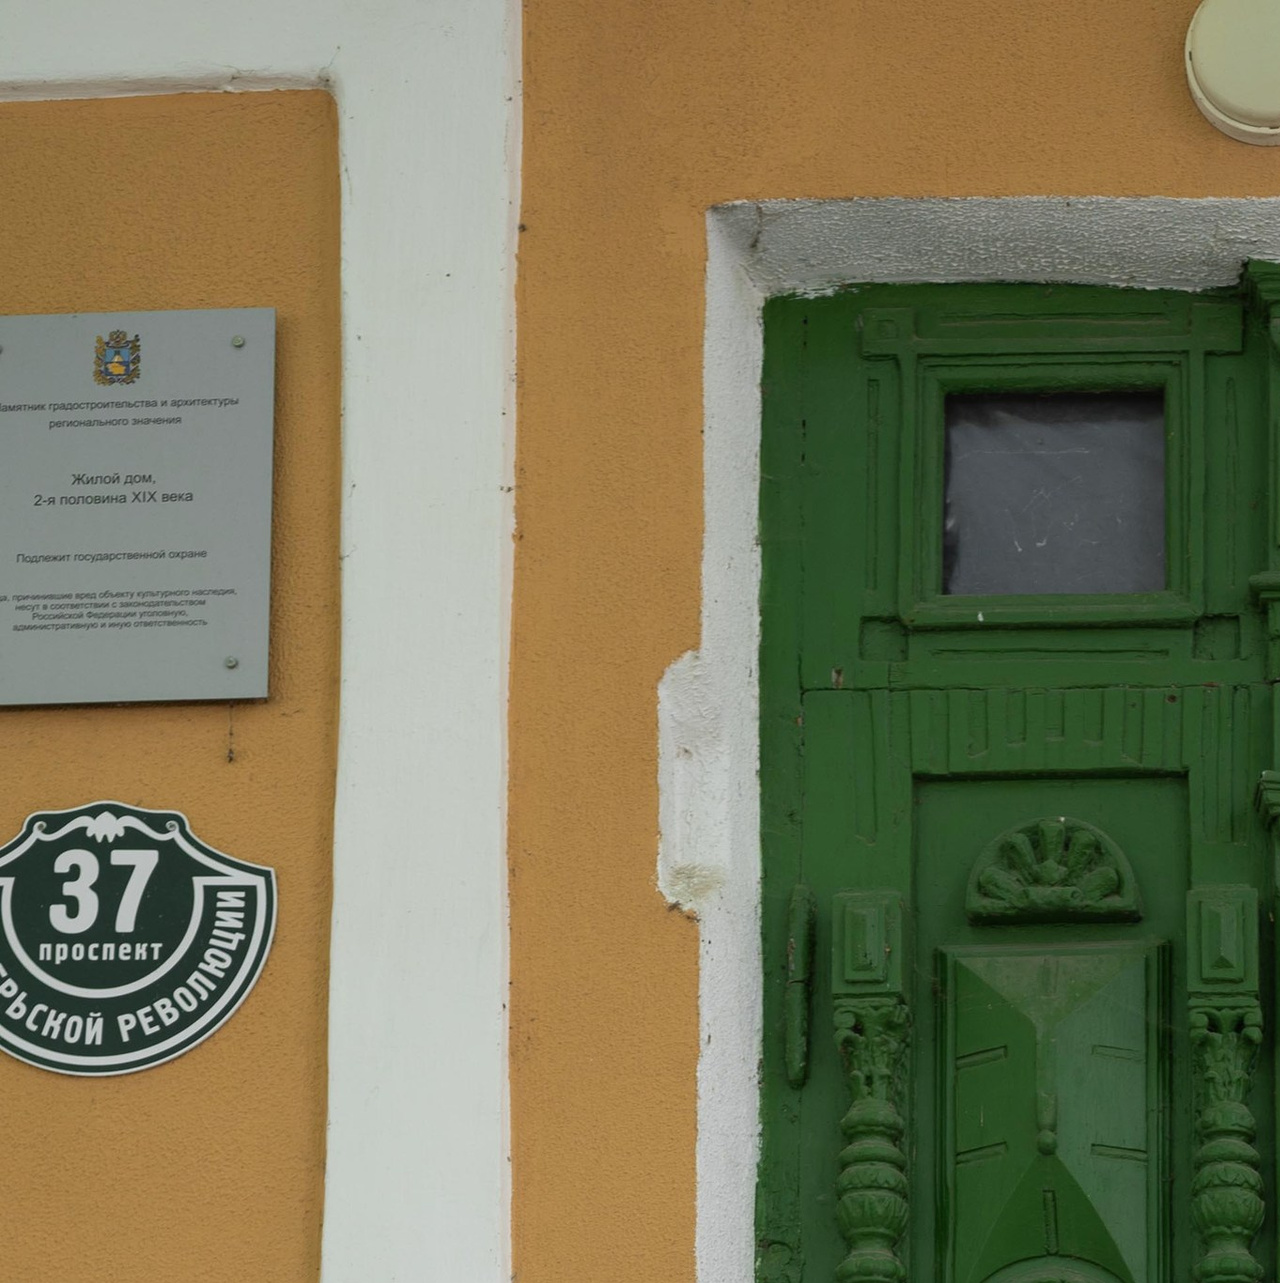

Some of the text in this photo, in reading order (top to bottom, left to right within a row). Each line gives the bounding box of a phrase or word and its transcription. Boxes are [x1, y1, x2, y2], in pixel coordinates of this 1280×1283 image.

[0, 403, 46, 412] амятник
[48, 400, 157, 412] градостроительства
[170, 398, 239, 408] архитектуры
[49, 417, 182, 430] регионального значения
[71, 473, 156, 485] Жилой дом,
[34, 494, 55, 506] 2-я
[60, 494, 127, 505] половина
[162, 492, 194, 502] века
[16, 550, 207, 563] Подлежит государственной охране
[49, 849, 159, 934] 37
[39, 943, 163, 965] проспект
[0, 891, 246, 1045] РЬСКОЙ РЕВОЛЮЦИИ
